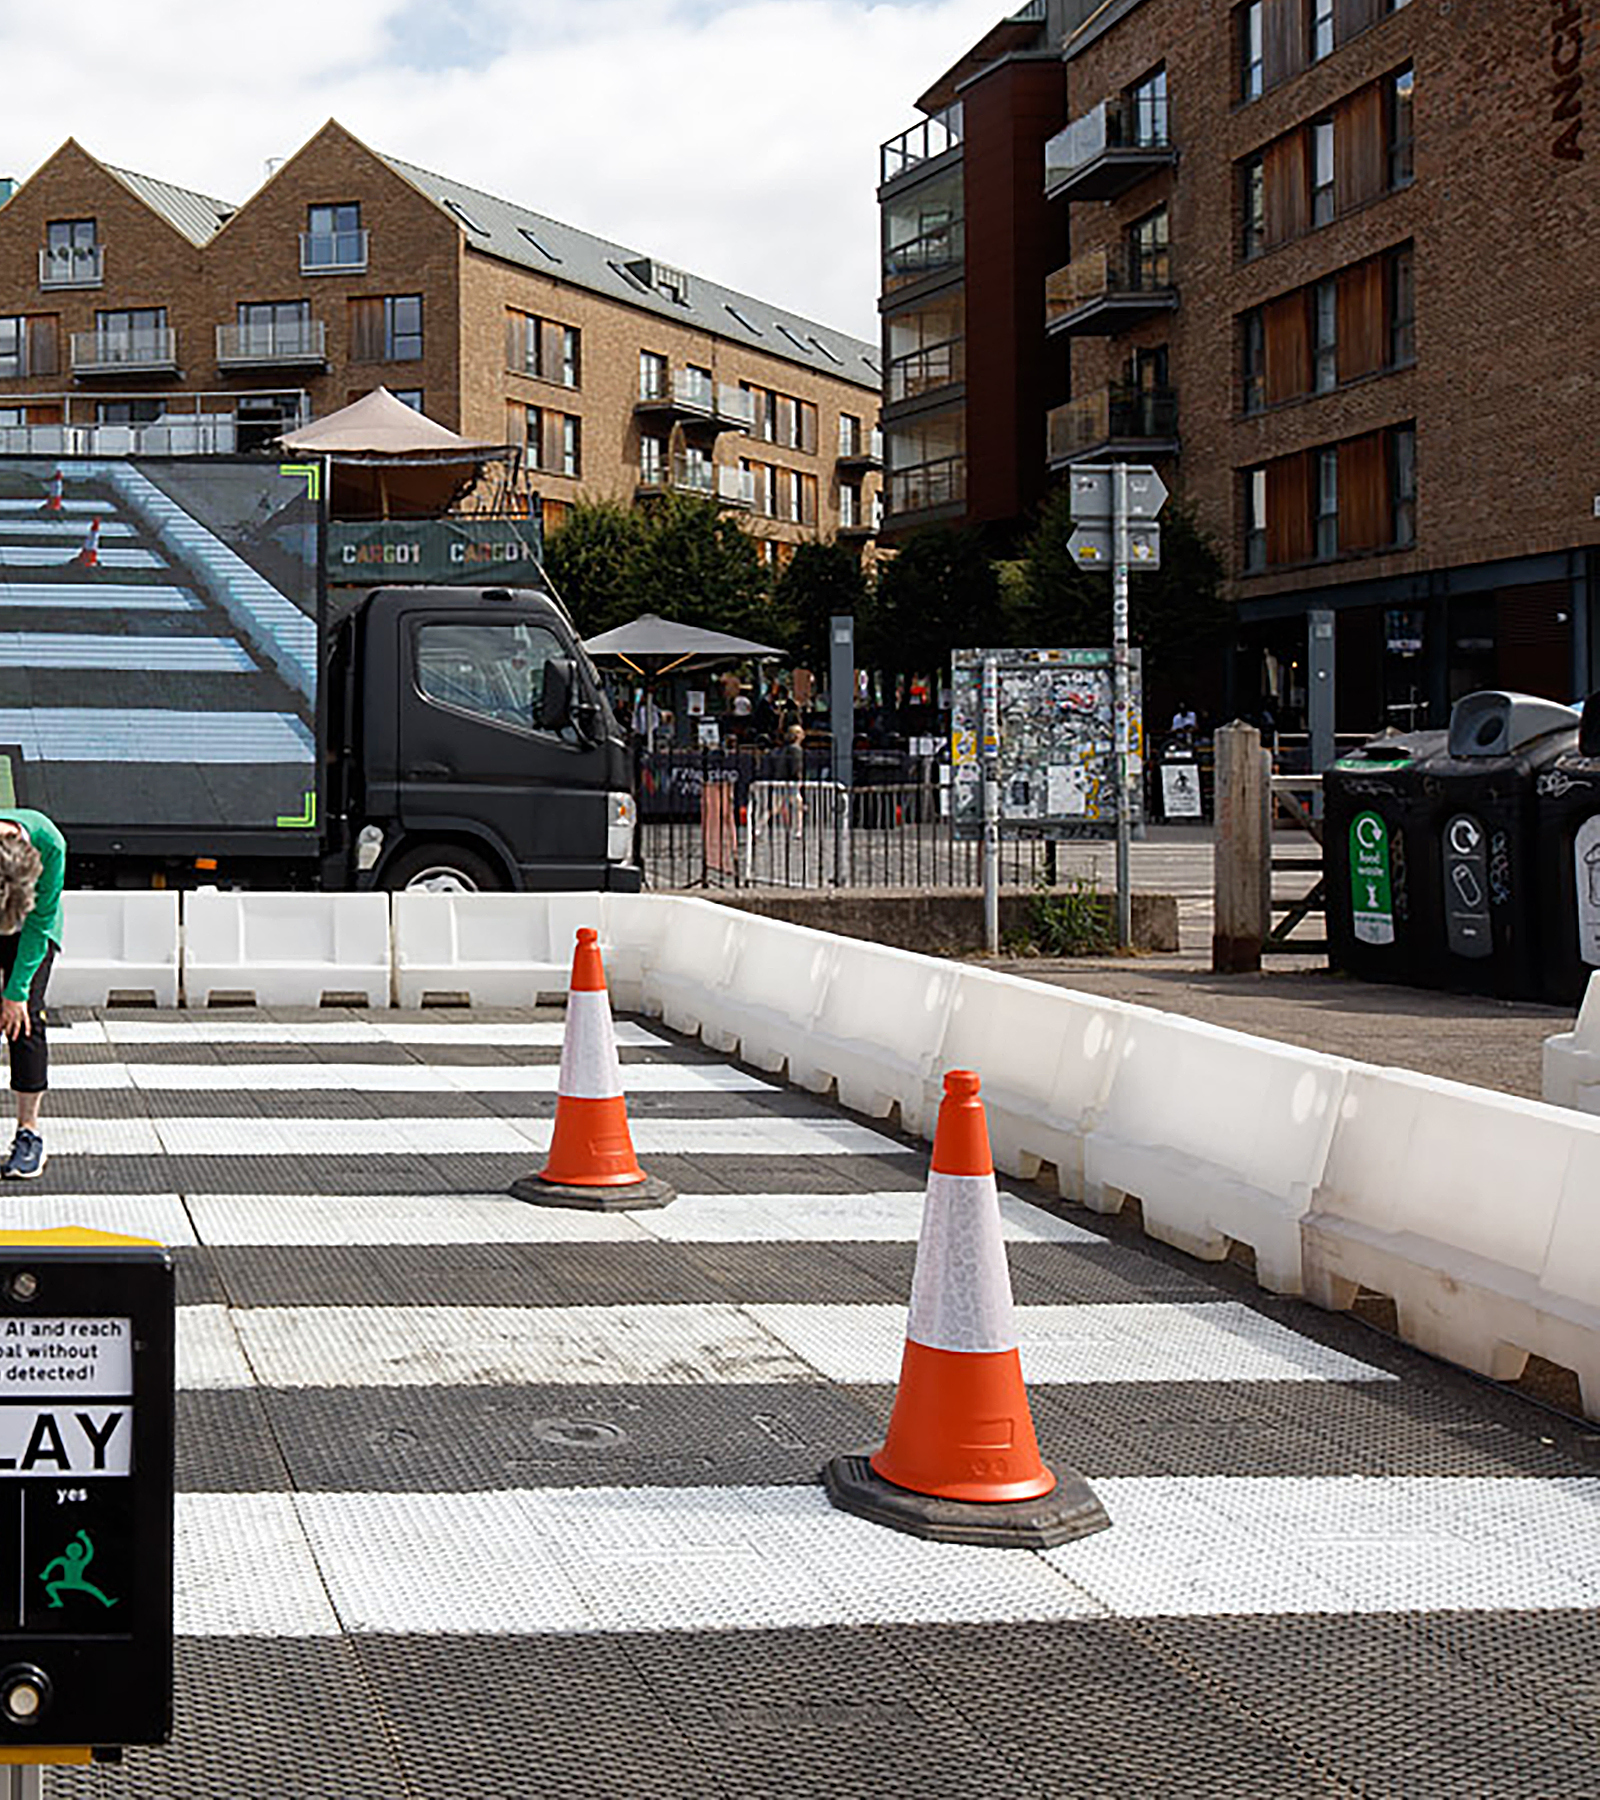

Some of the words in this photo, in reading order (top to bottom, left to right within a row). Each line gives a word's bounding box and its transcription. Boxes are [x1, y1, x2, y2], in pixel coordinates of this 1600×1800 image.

[343, 543, 420, 564] CARGO1
[450, 542, 529, 563] CARGO1
[5, 1322, 25, 1337] AI
[31, 1322, 65, 1337] and
[71, 1322, 122, 1337] reach
[26, 1344, 99, 1359] without
[6, 1365, 94, 1381] detected!
[57, 1488, 89, 1505] yes
